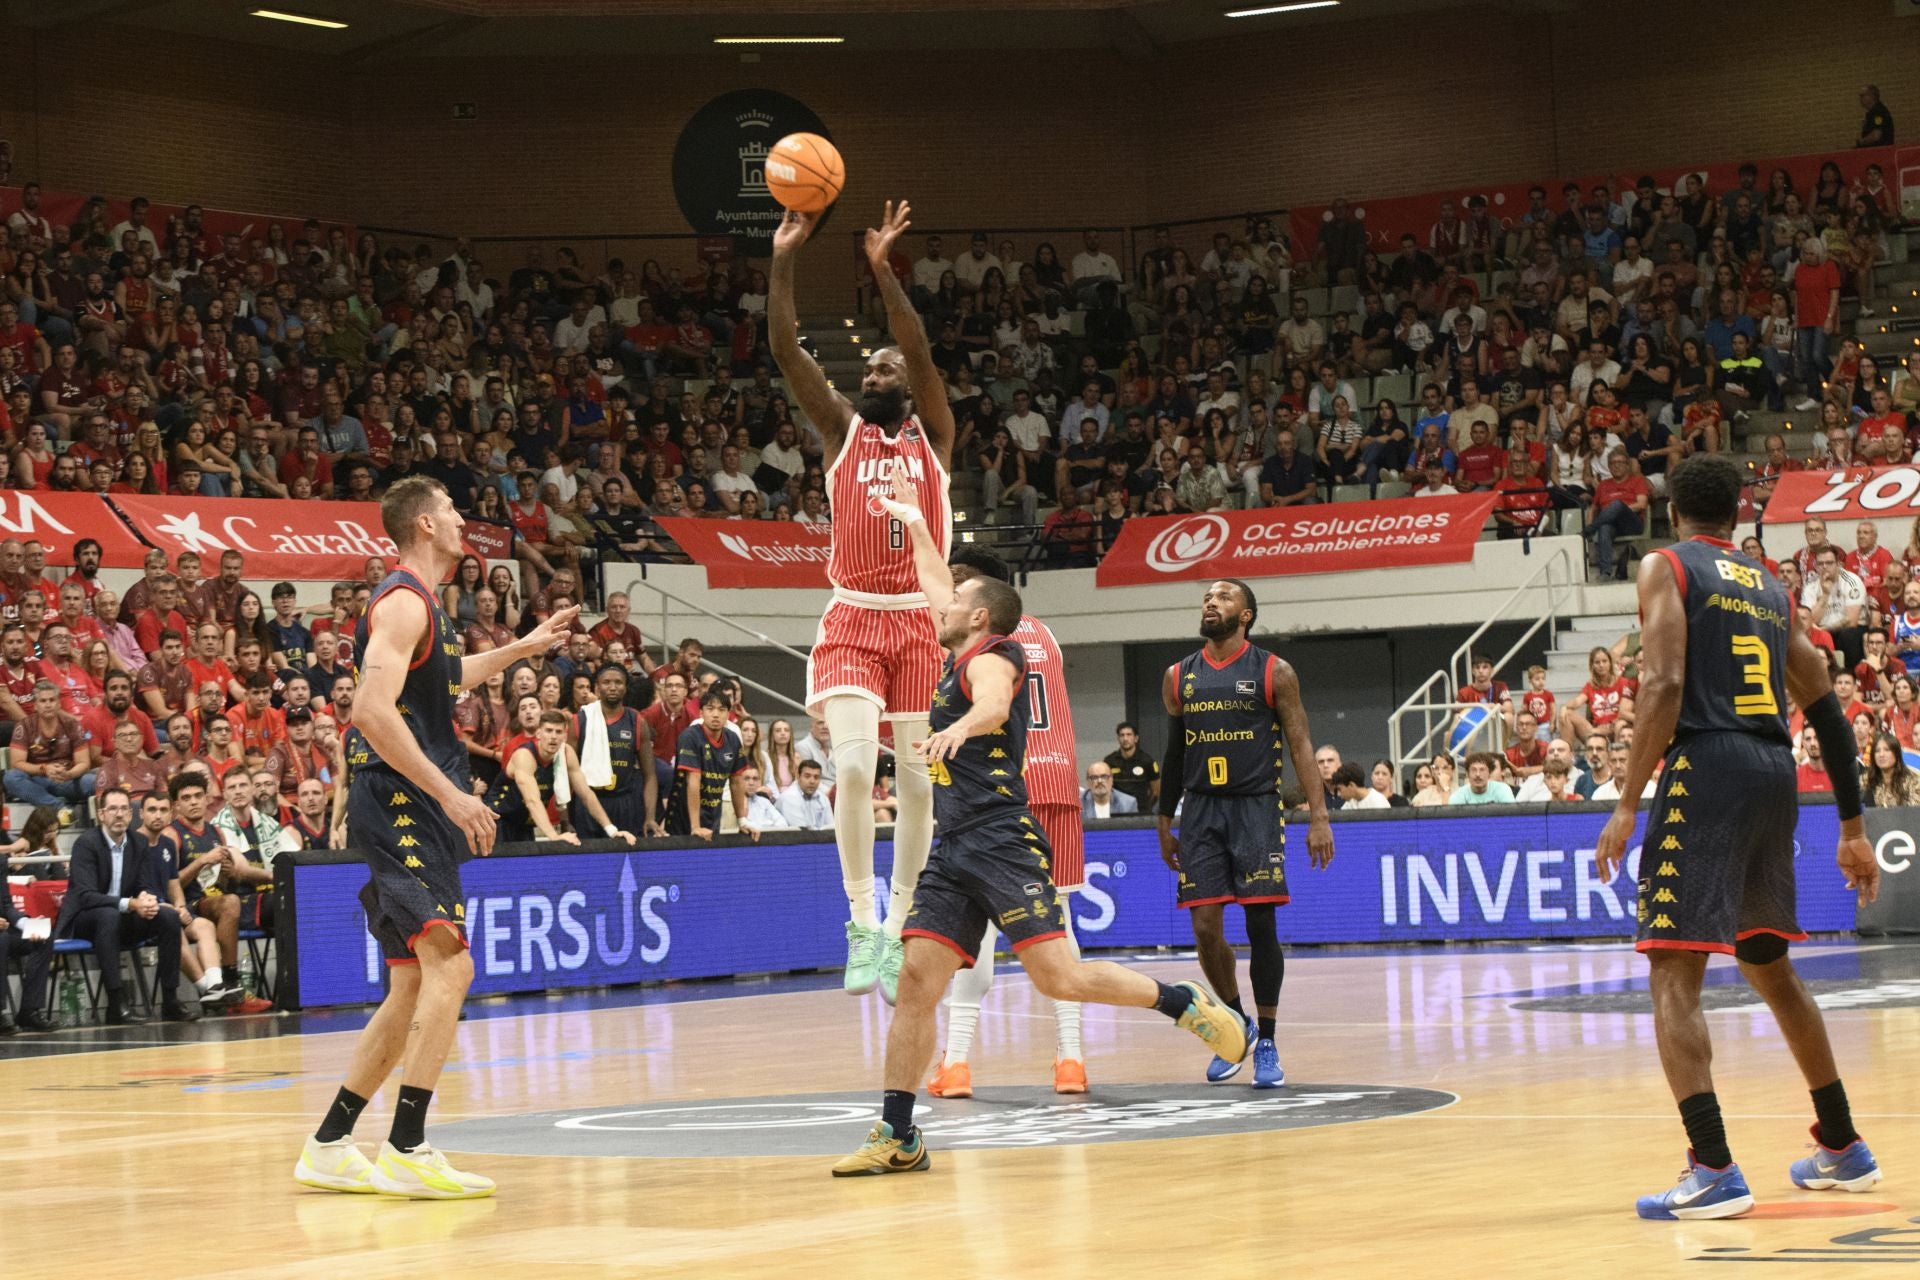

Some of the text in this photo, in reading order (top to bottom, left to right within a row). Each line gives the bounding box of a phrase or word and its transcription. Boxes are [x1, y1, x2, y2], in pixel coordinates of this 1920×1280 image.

[856, 455, 925, 483] UCAM
[1803, 467, 1920, 514] ZO
[467, 532, 504, 548] MÓDULO
[888, 517, 905, 549] 8
[1242, 511, 1451, 542] OC Soluciones
[478, 545, 489, 554] 10
[1232, 531, 1442, 559] Medioambientales
[1715, 560, 1764, 590] BEST
[1720, 596, 1786, 630] MORABANC
[1731, 634, 1779, 715] 3
[1190, 700, 1255, 713] MORABANC
[1198, 728, 1255, 743] Andorra
[1208, 756, 1228, 786] 0
